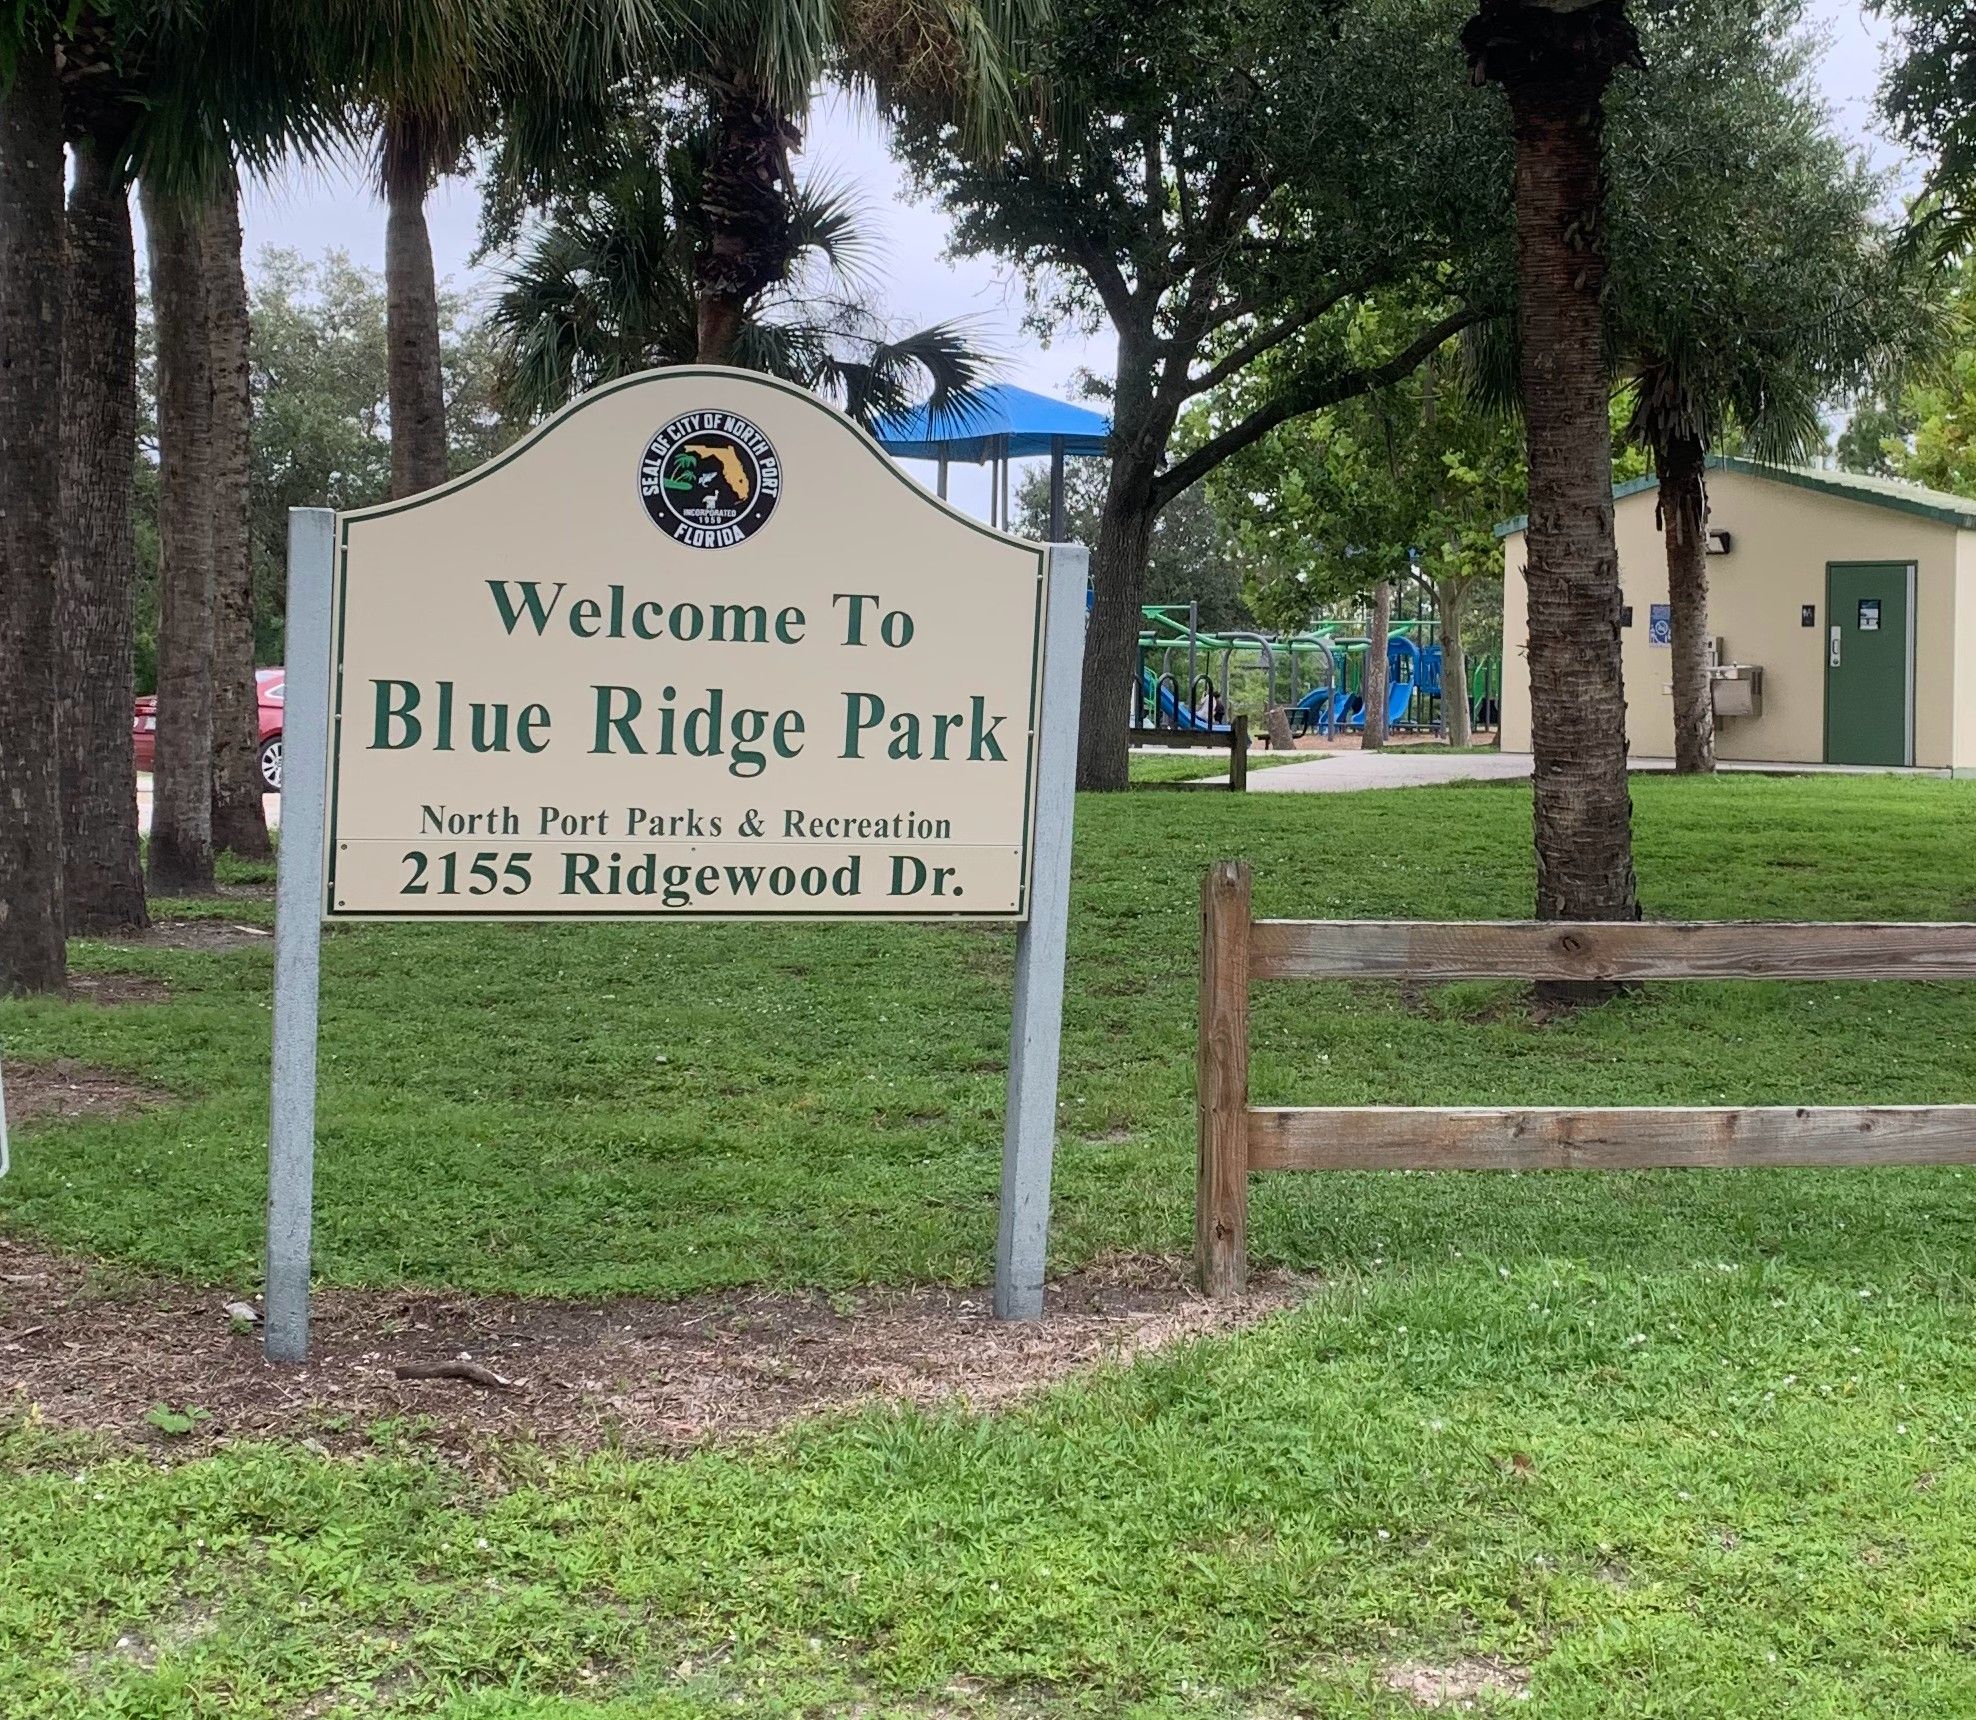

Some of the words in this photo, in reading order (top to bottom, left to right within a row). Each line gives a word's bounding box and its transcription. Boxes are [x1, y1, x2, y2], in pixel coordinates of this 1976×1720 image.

[667, 414, 700, 441] CITY
[704, 414, 722, 430] OF
[723, 416, 769, 455] NORTH
[651, 435, 671, 456] OF
[642, 458, 662, 496] SEAL
[759, 456, 779, 498] PORT
[683, 508, 737, 517] INCORPORATED
[674, 523, 745, 547] FLORIDA
[485, 580, 805, 644] Welcome
[833, 594, 914, 648] To
[366, 680, 551, 753] Blue
[587, 685, 805, 778] Ridge
[838, 692, 1007, 761] Park
[420, 804, 520, 836] North
[539, 806, 609, 836] Port
[627, 807, 722, 838] Parks
[739, 808, 765, 838] &
[783, 809, 951, 840] Recreation
[400, 851, 533, 895] 2155
[559, 853, 862, 906] Ridgewood
[886, 856, 964, 896] Dr.
